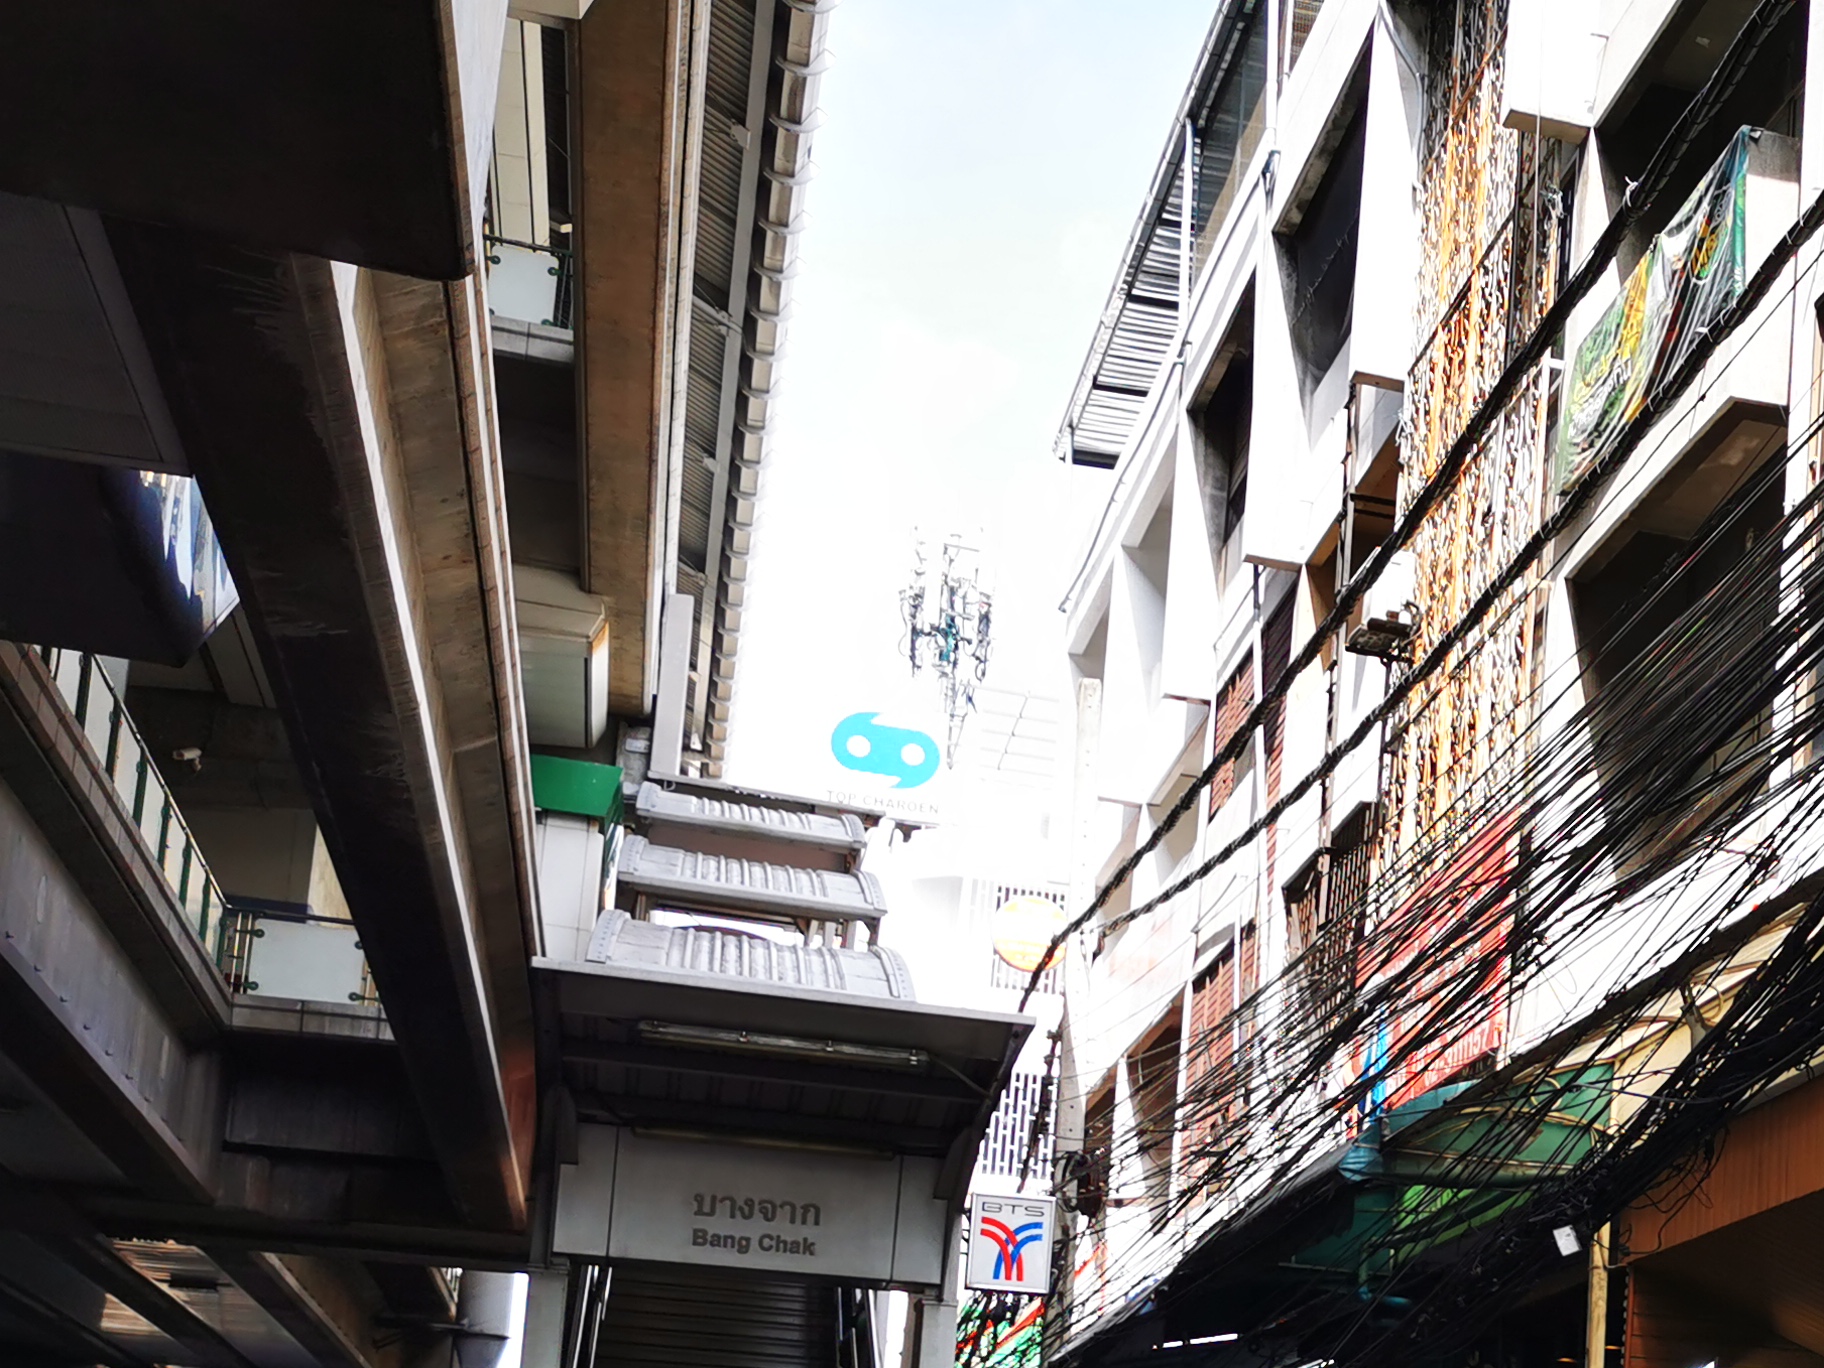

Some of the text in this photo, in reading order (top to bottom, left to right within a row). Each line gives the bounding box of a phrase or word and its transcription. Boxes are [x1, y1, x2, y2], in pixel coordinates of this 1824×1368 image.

[826, 789, 940, 815] TOP CHAROEN
[693, 1191, 822, 1227] บางจาก
[981, 1201, 1045, 1218] BTS
[692, 1227, 816, 1257] Bang Chak
